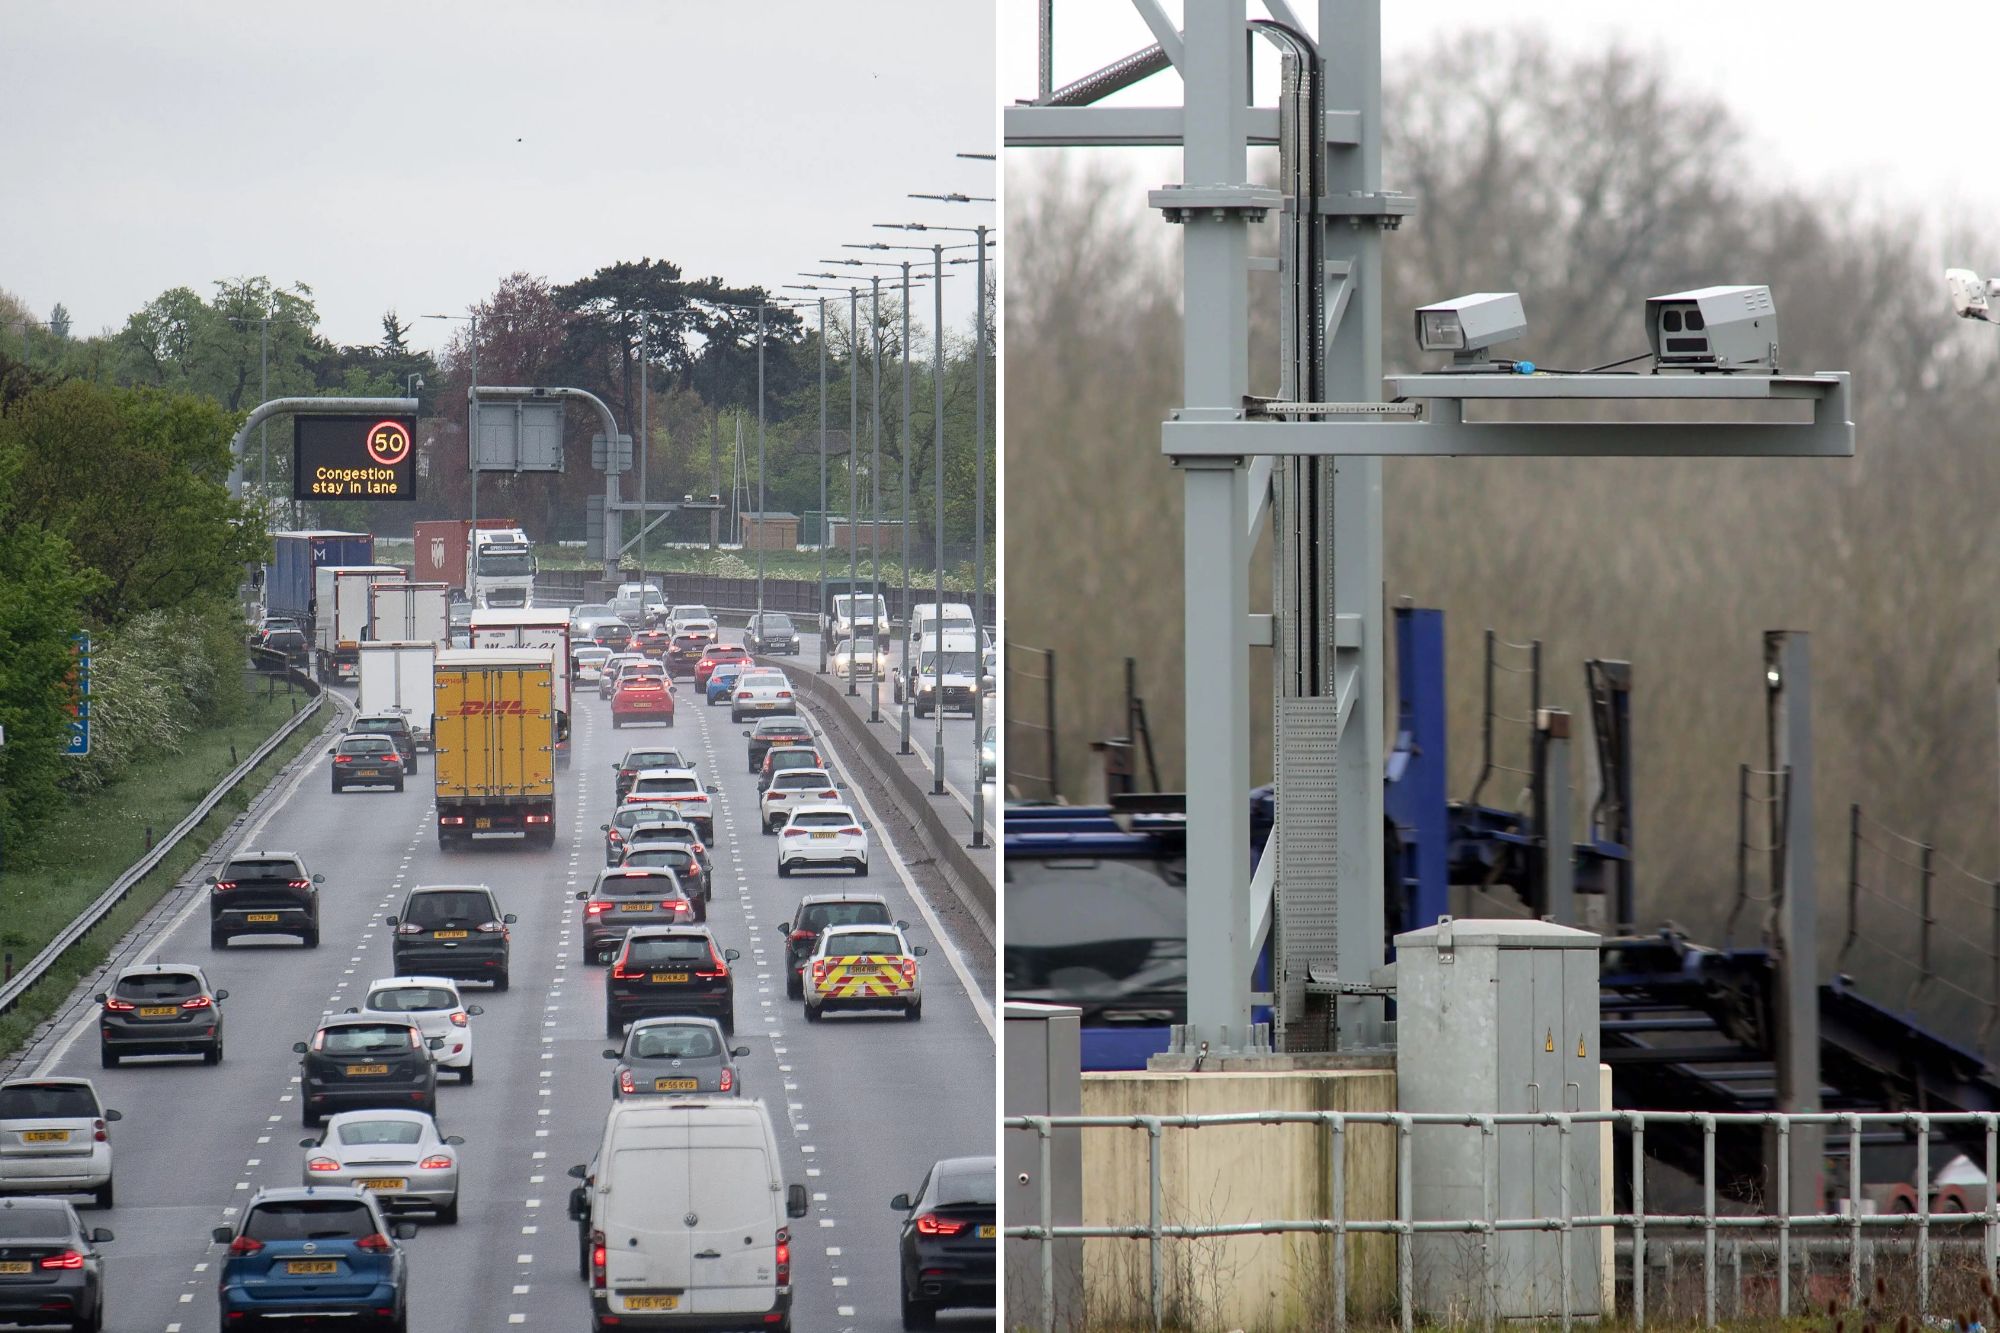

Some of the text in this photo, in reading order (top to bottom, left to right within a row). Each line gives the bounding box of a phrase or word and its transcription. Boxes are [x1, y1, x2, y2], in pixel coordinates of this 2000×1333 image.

[375, 433, 403, 452] 50
[316, 467, 394, 482] Congestion
[312, 481, 398, 495] stay in lane
[458, 700, 528, 716] DHL
